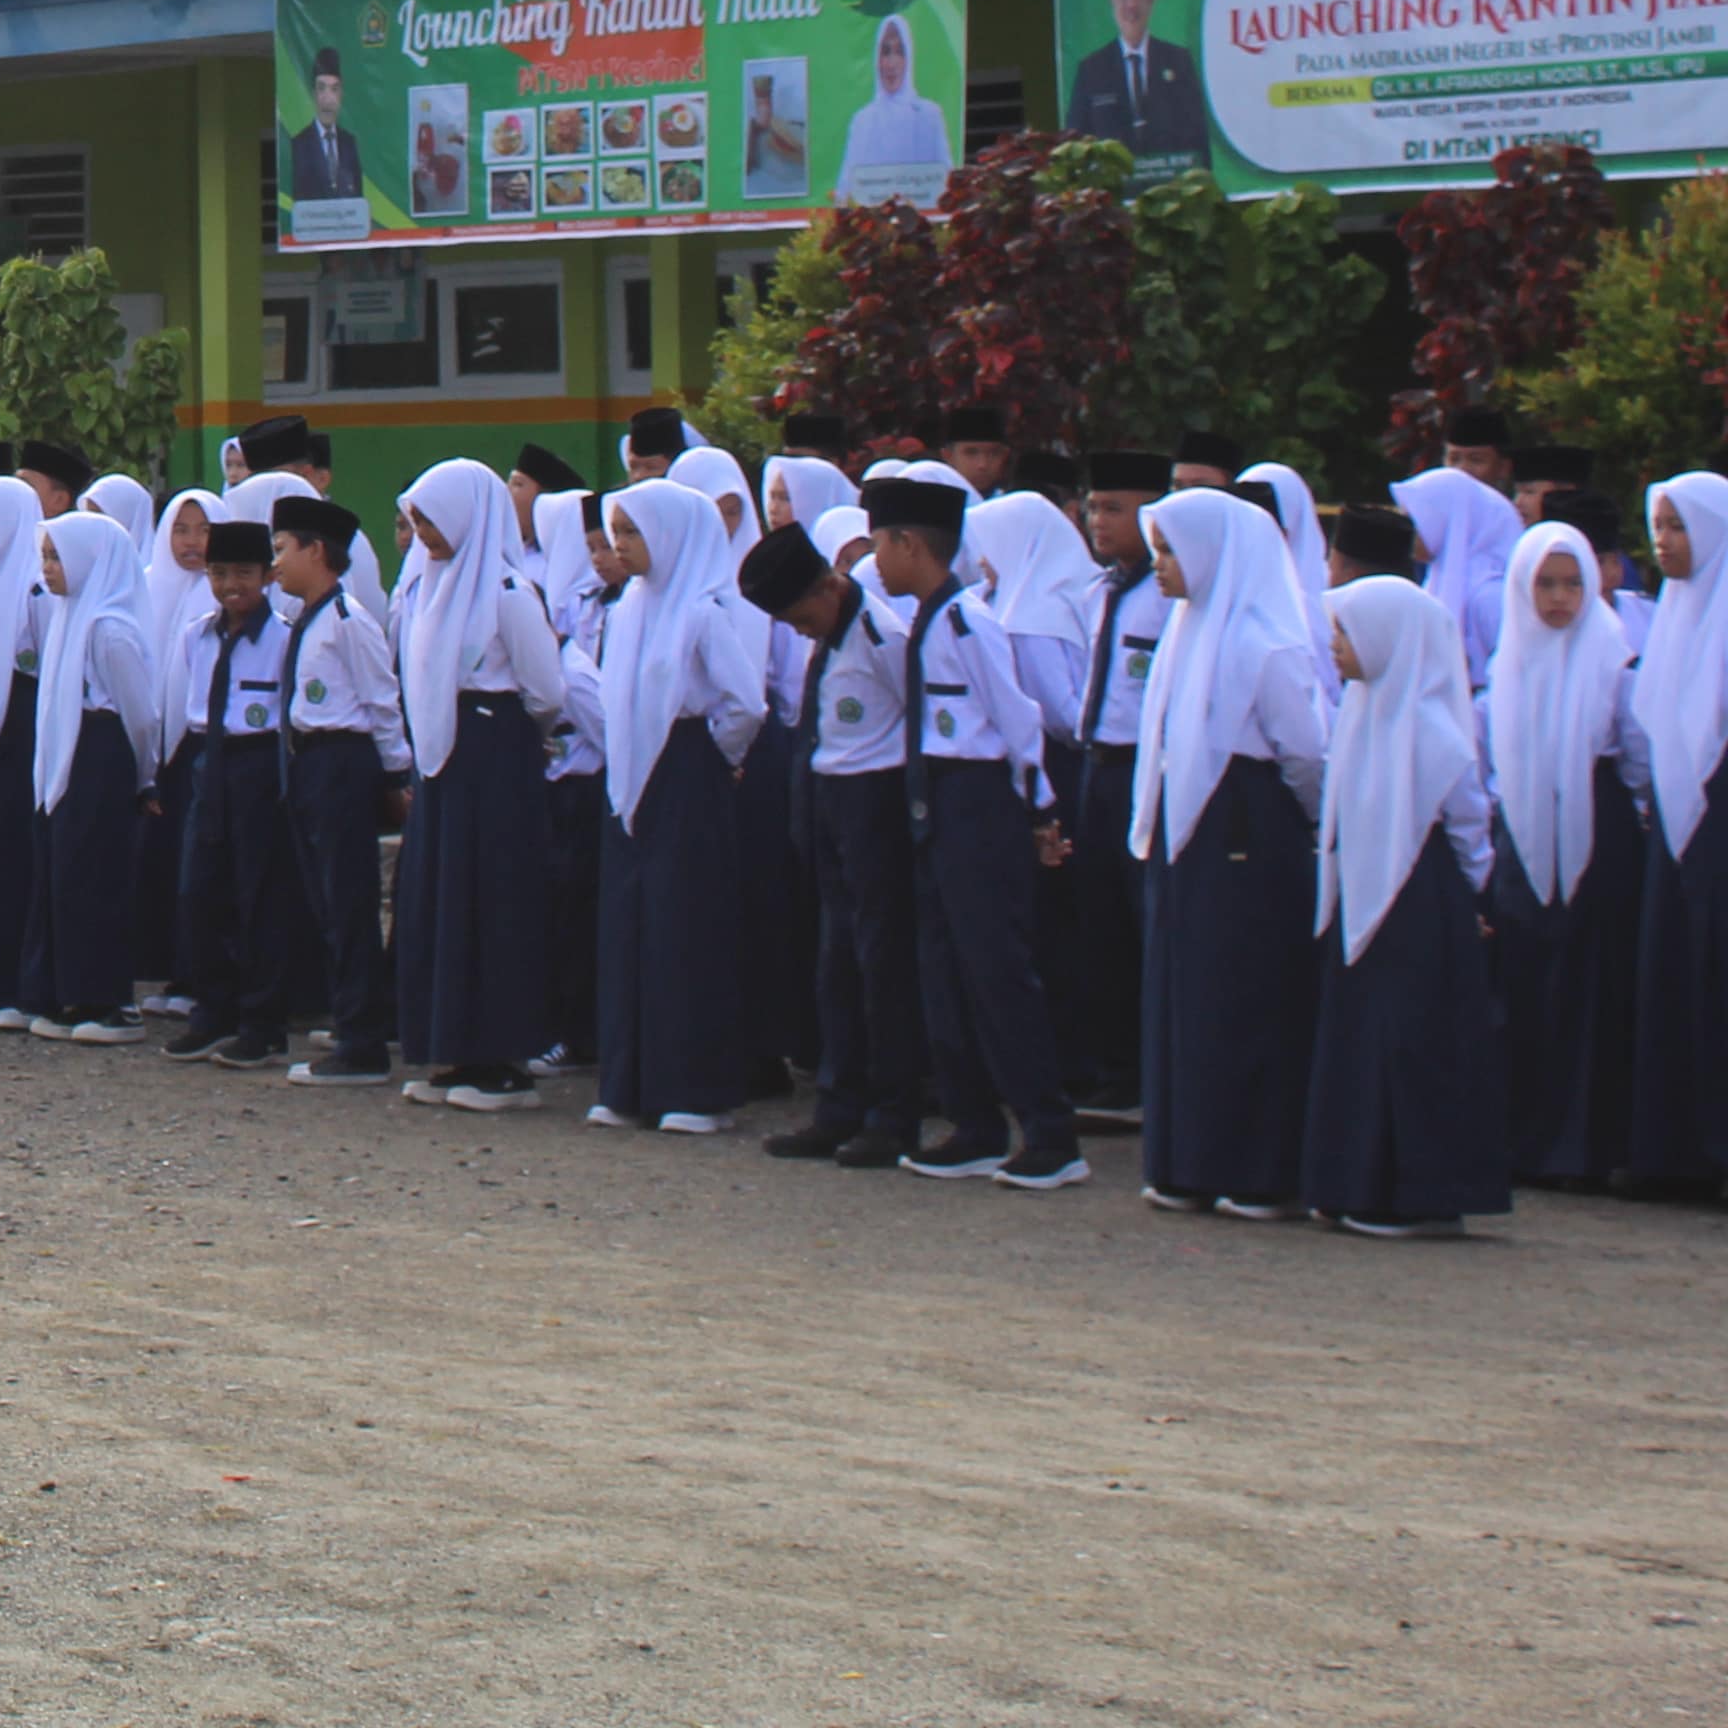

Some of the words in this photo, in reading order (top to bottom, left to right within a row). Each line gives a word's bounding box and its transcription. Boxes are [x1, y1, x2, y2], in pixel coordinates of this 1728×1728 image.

[608, 47, 705, 86] Kerinci
[1285, 84, 1356, 101] BERSAMA
[1404, 140, 1428, 161] DI
